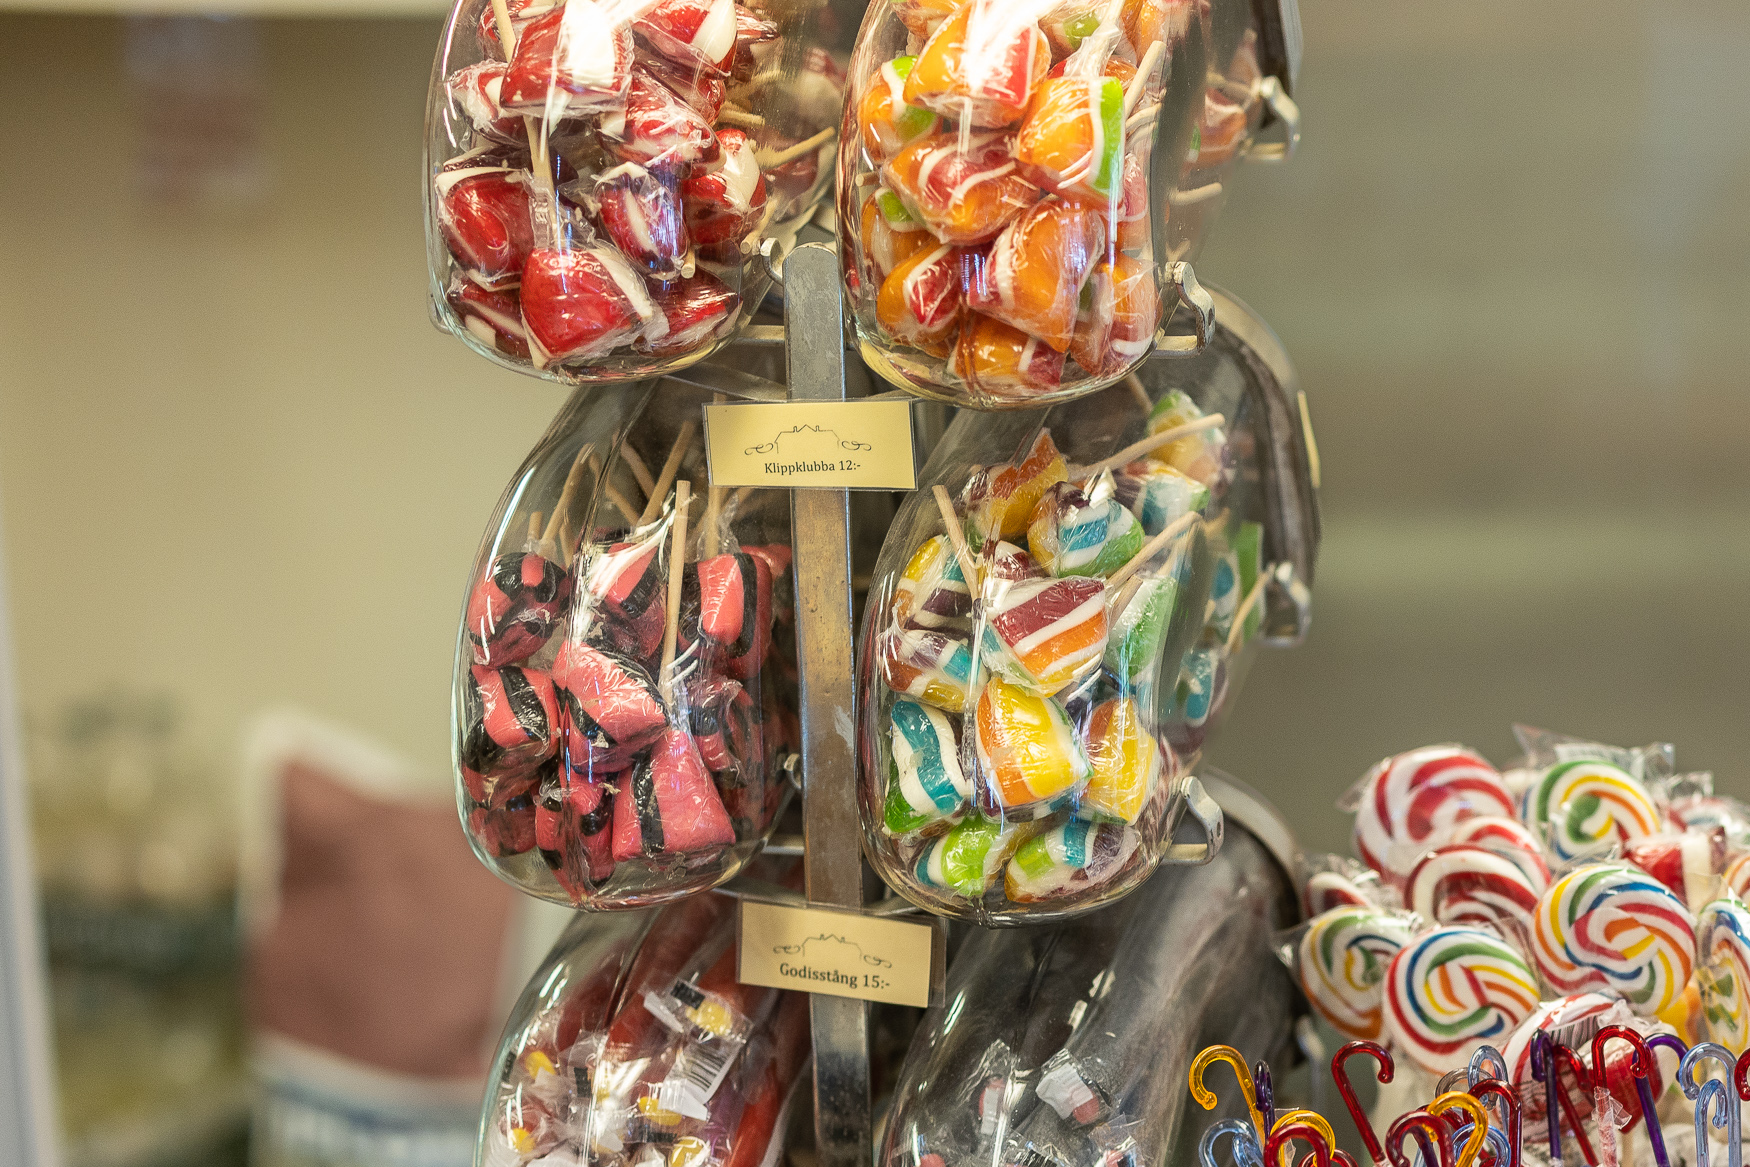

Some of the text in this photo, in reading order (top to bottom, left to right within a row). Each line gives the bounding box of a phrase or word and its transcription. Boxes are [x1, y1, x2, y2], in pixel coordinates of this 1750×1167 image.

[764, 459, 861, 476] Klippklubba 12:-
[779, 961, 890, 989] Godisstång 15:-
